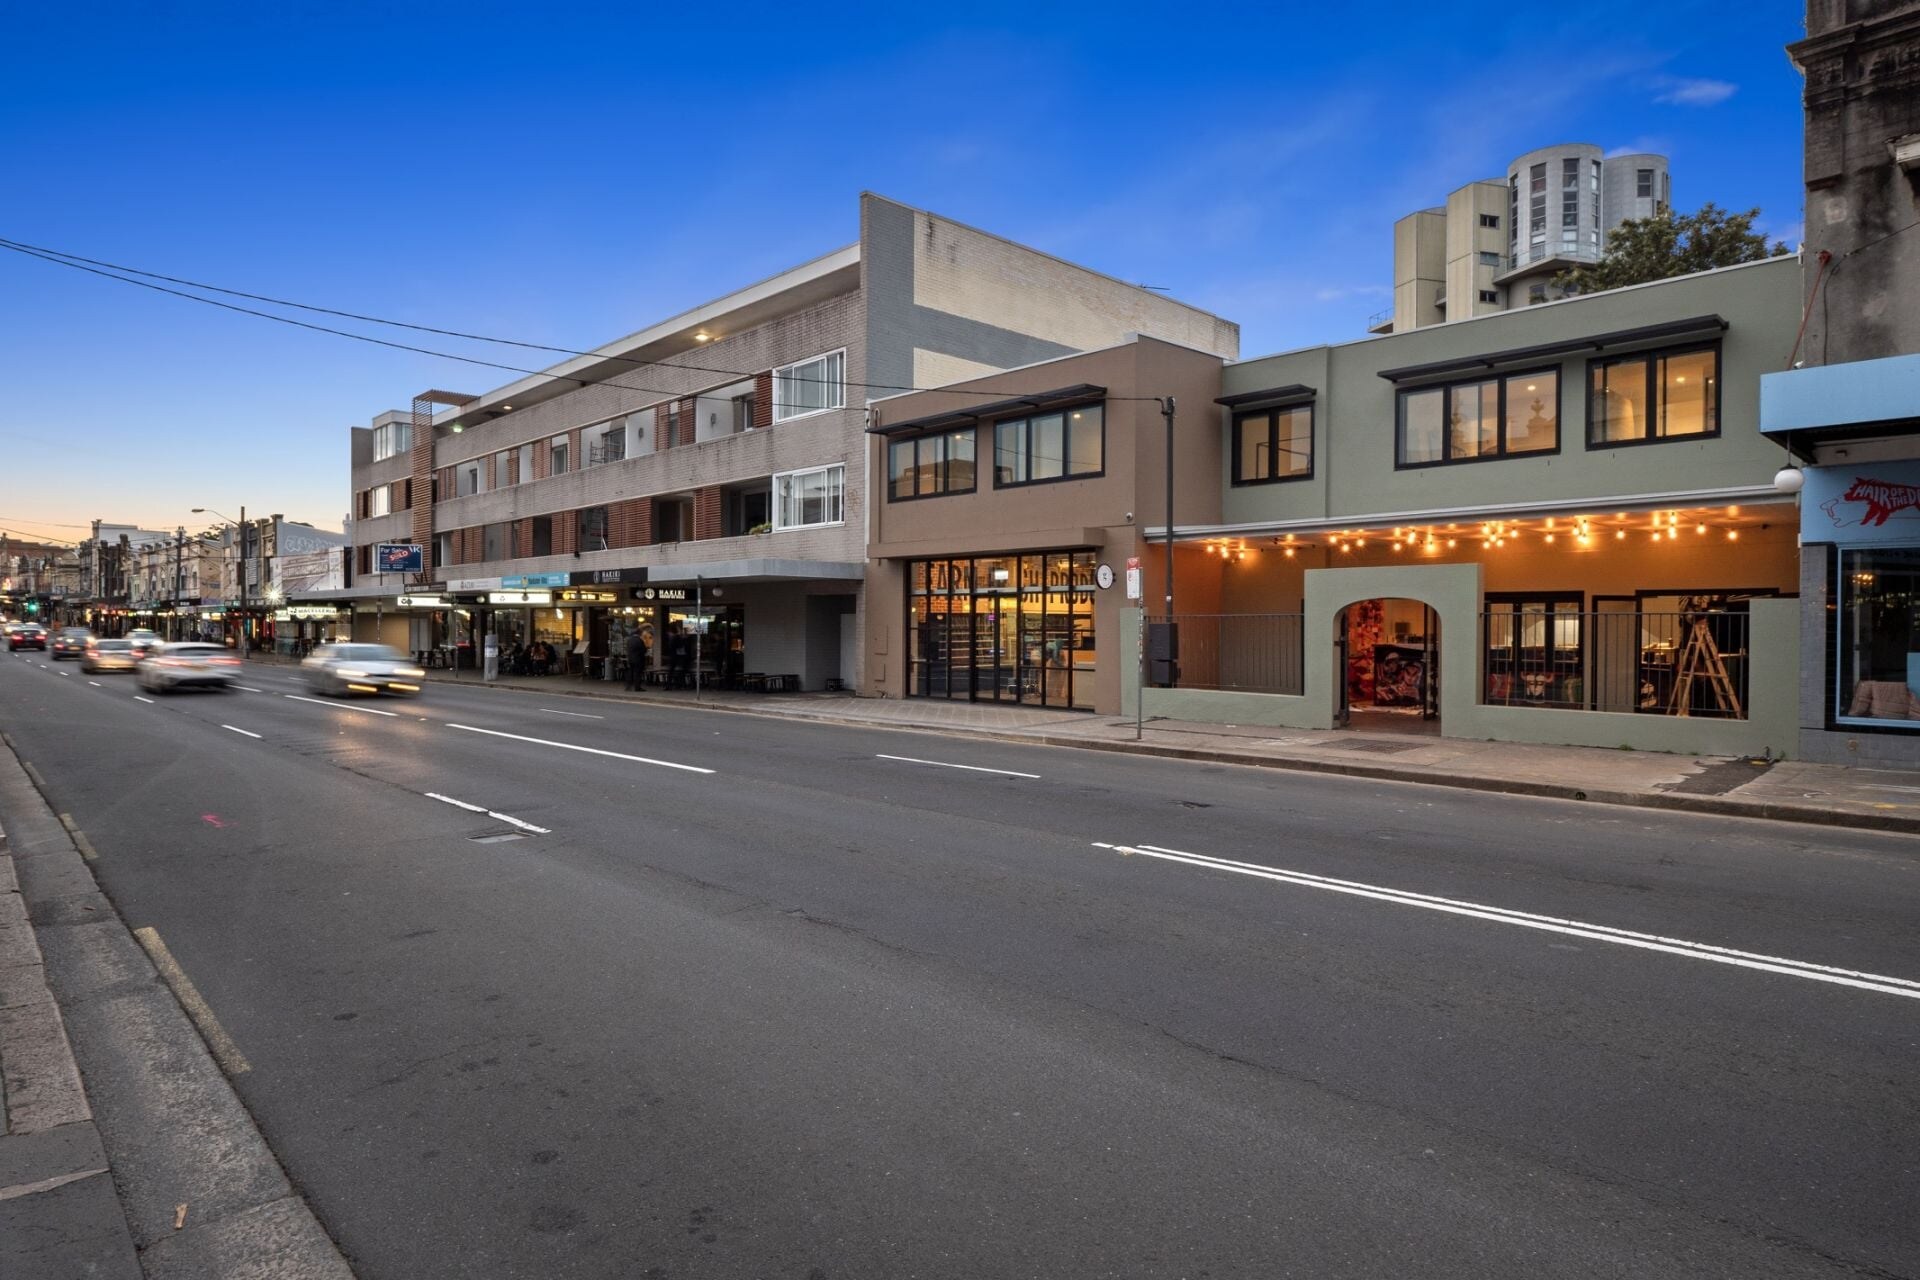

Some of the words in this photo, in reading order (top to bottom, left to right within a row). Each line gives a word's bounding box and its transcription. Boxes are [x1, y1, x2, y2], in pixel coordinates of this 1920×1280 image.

[1853, 484, 1891, 509] HAIR
[1890, 488, 1904, 496] OF
[1889, 497, 1907, 507] THE
